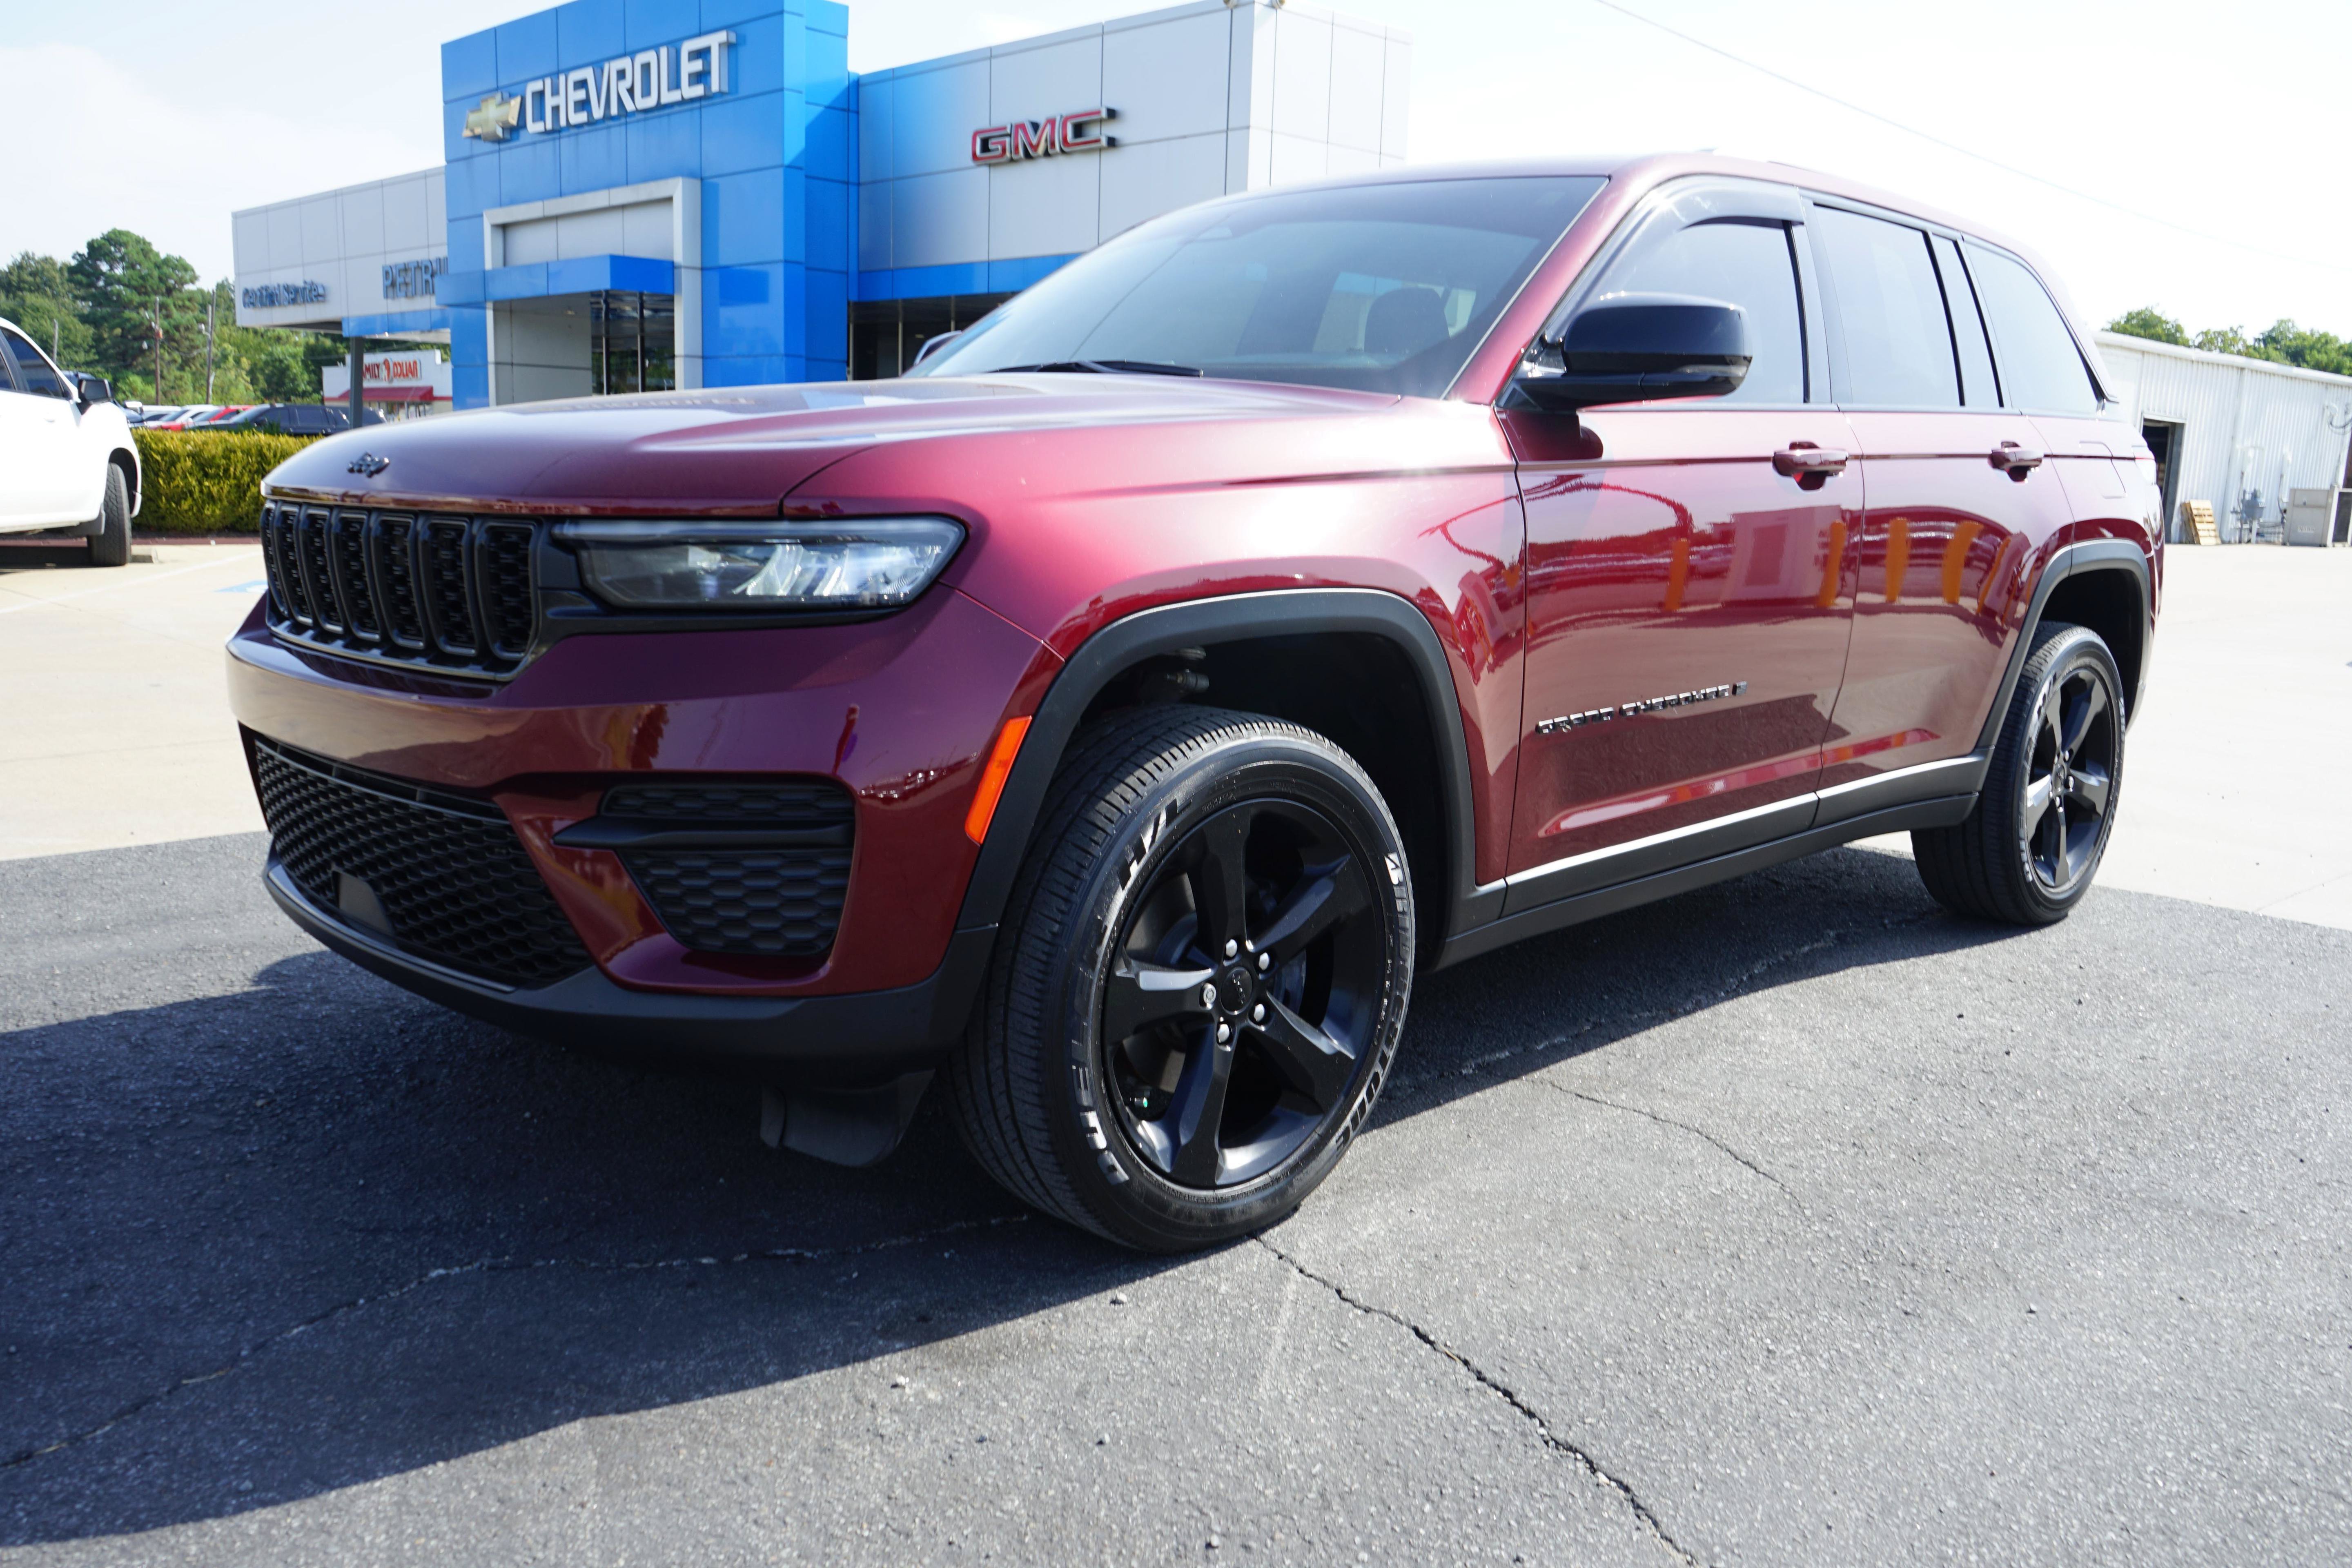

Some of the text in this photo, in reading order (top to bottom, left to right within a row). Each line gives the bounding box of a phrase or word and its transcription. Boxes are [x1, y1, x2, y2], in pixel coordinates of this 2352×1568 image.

[526, 30, 736, 134] CHEVROLET
[972, 107, 1116, 163] GMC
[1535, 684, 1730, 734] GRAND CHEROKEE
